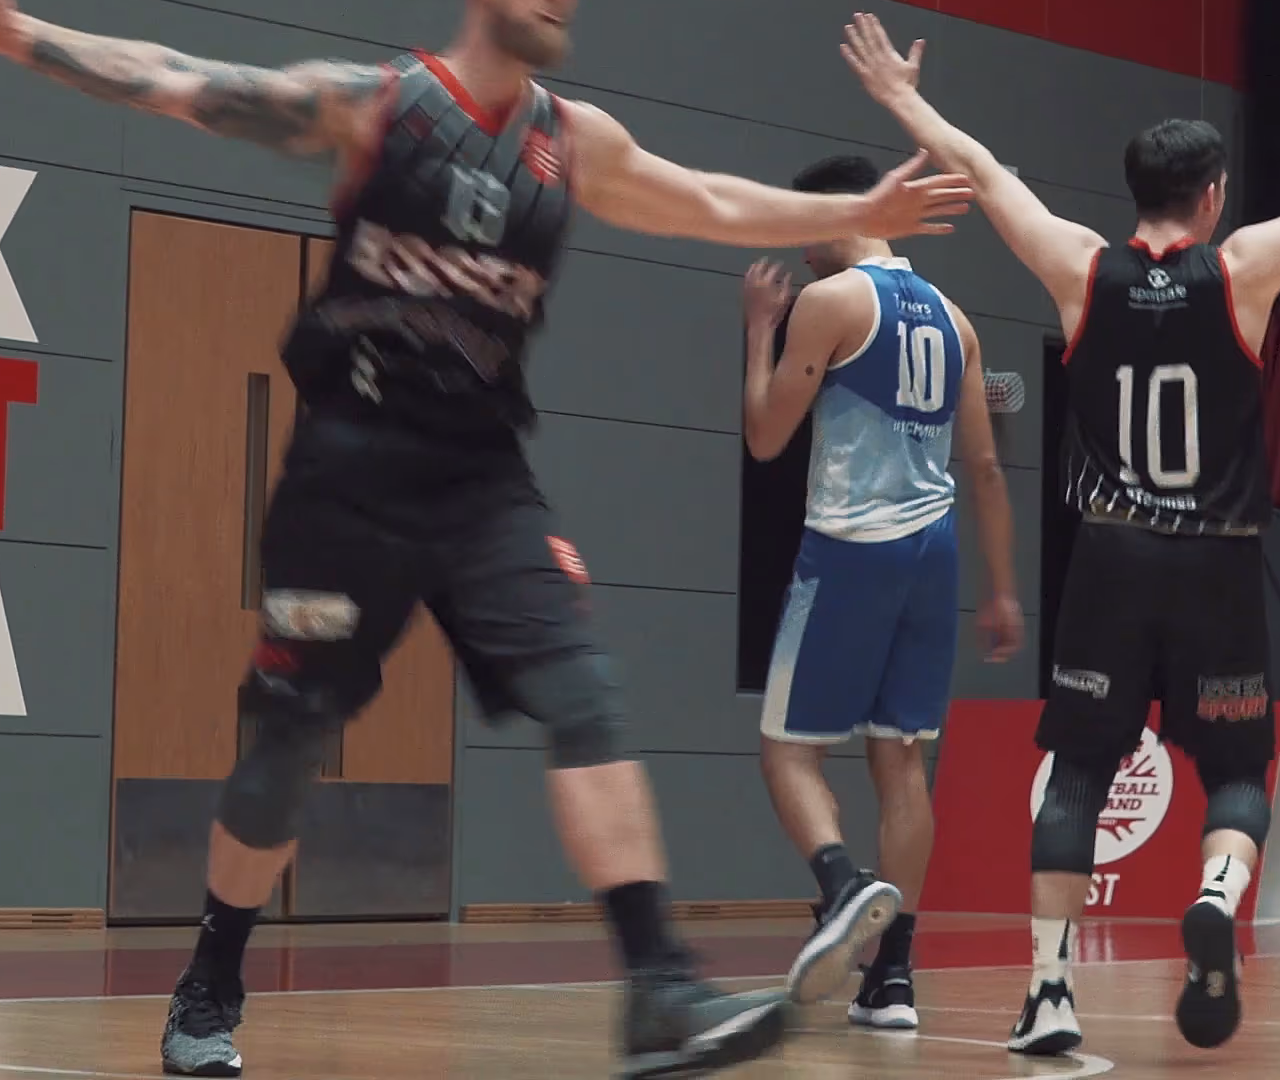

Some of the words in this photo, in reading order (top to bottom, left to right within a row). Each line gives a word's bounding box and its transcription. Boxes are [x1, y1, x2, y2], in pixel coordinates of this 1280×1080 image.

[896, 320, 946, 413] 10
[1116, 363, 1200, 489] 10
[1112, 782, 1160, 796] BALL
